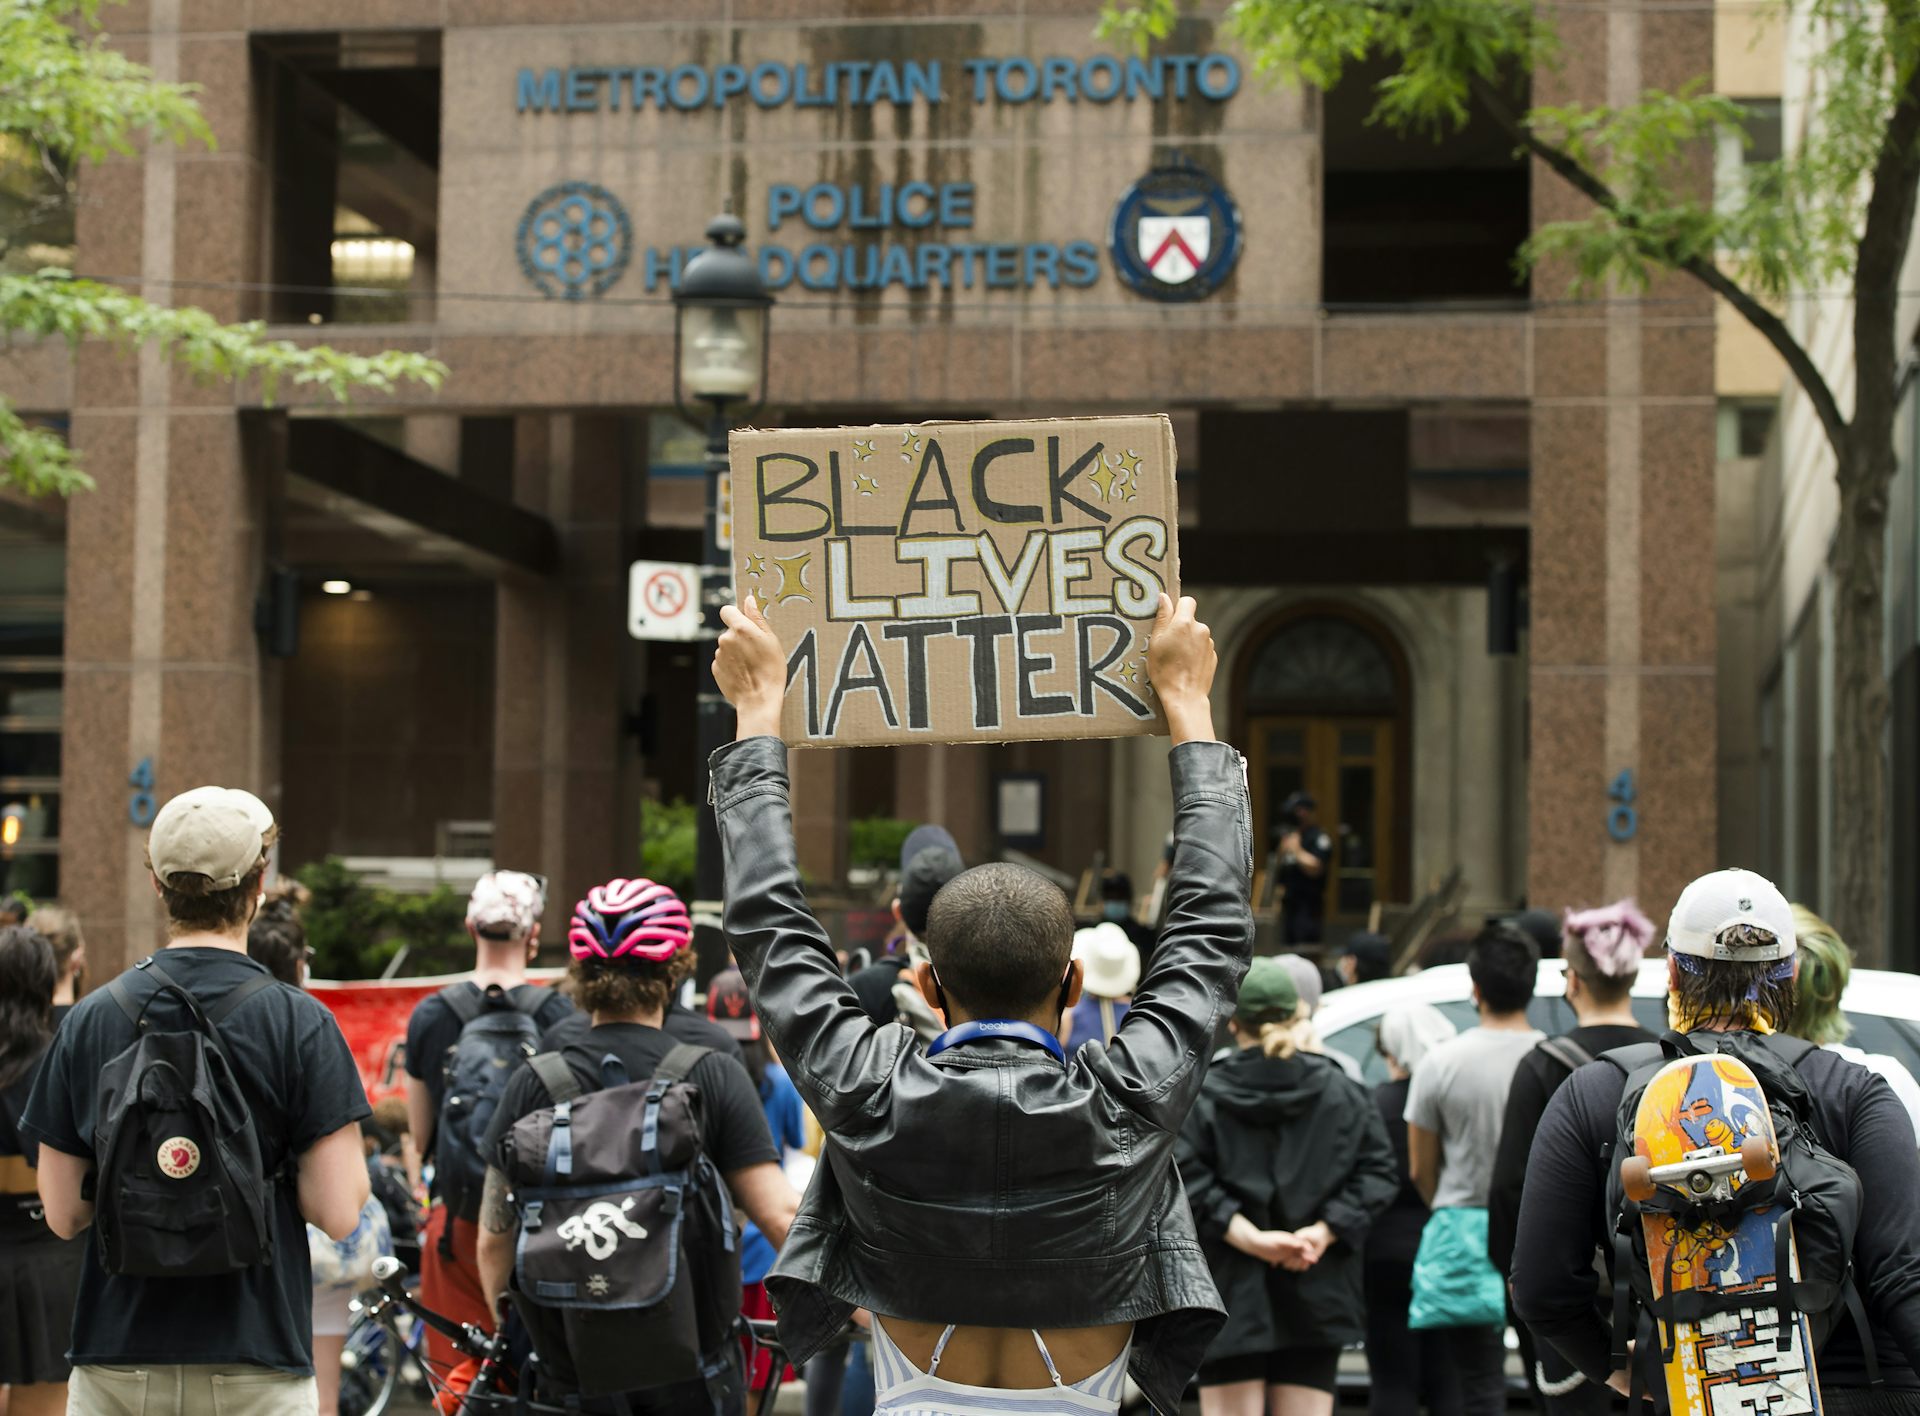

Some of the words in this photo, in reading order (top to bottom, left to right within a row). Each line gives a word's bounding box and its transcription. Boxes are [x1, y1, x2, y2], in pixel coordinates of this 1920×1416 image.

[516, 59, 942, 112] METROPOLITAN
[964, 53, 1241, 104] TORONTO
[768, 181, 976, 231] POLICE
[644, 241, 1100, 290] HDQUARTERS
[756, 435, 1111, 542] BLACK
[824, 515, 1168, 622] LIVES
[979, 1021, 1009, 1031] beats
